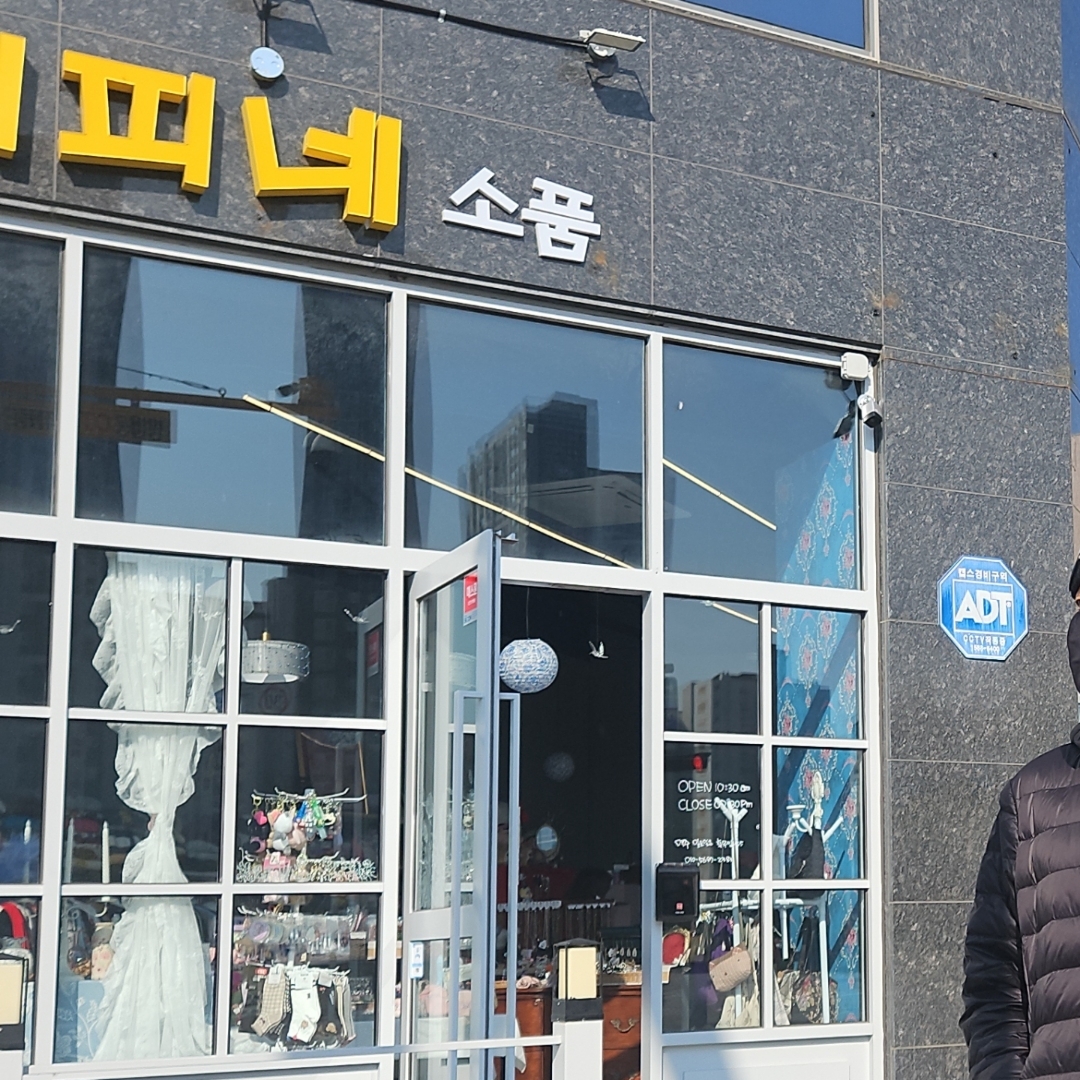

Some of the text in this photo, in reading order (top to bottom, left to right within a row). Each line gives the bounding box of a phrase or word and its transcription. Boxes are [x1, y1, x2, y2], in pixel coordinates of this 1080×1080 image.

[442, 167, 600, 262] 소품
[954, 589, 1012, 626] ADT
[678, 780, 712, 793] OPEN
[715, 782, 739, 793] 10:30
[678, 798, 712, 811] CLOSE
